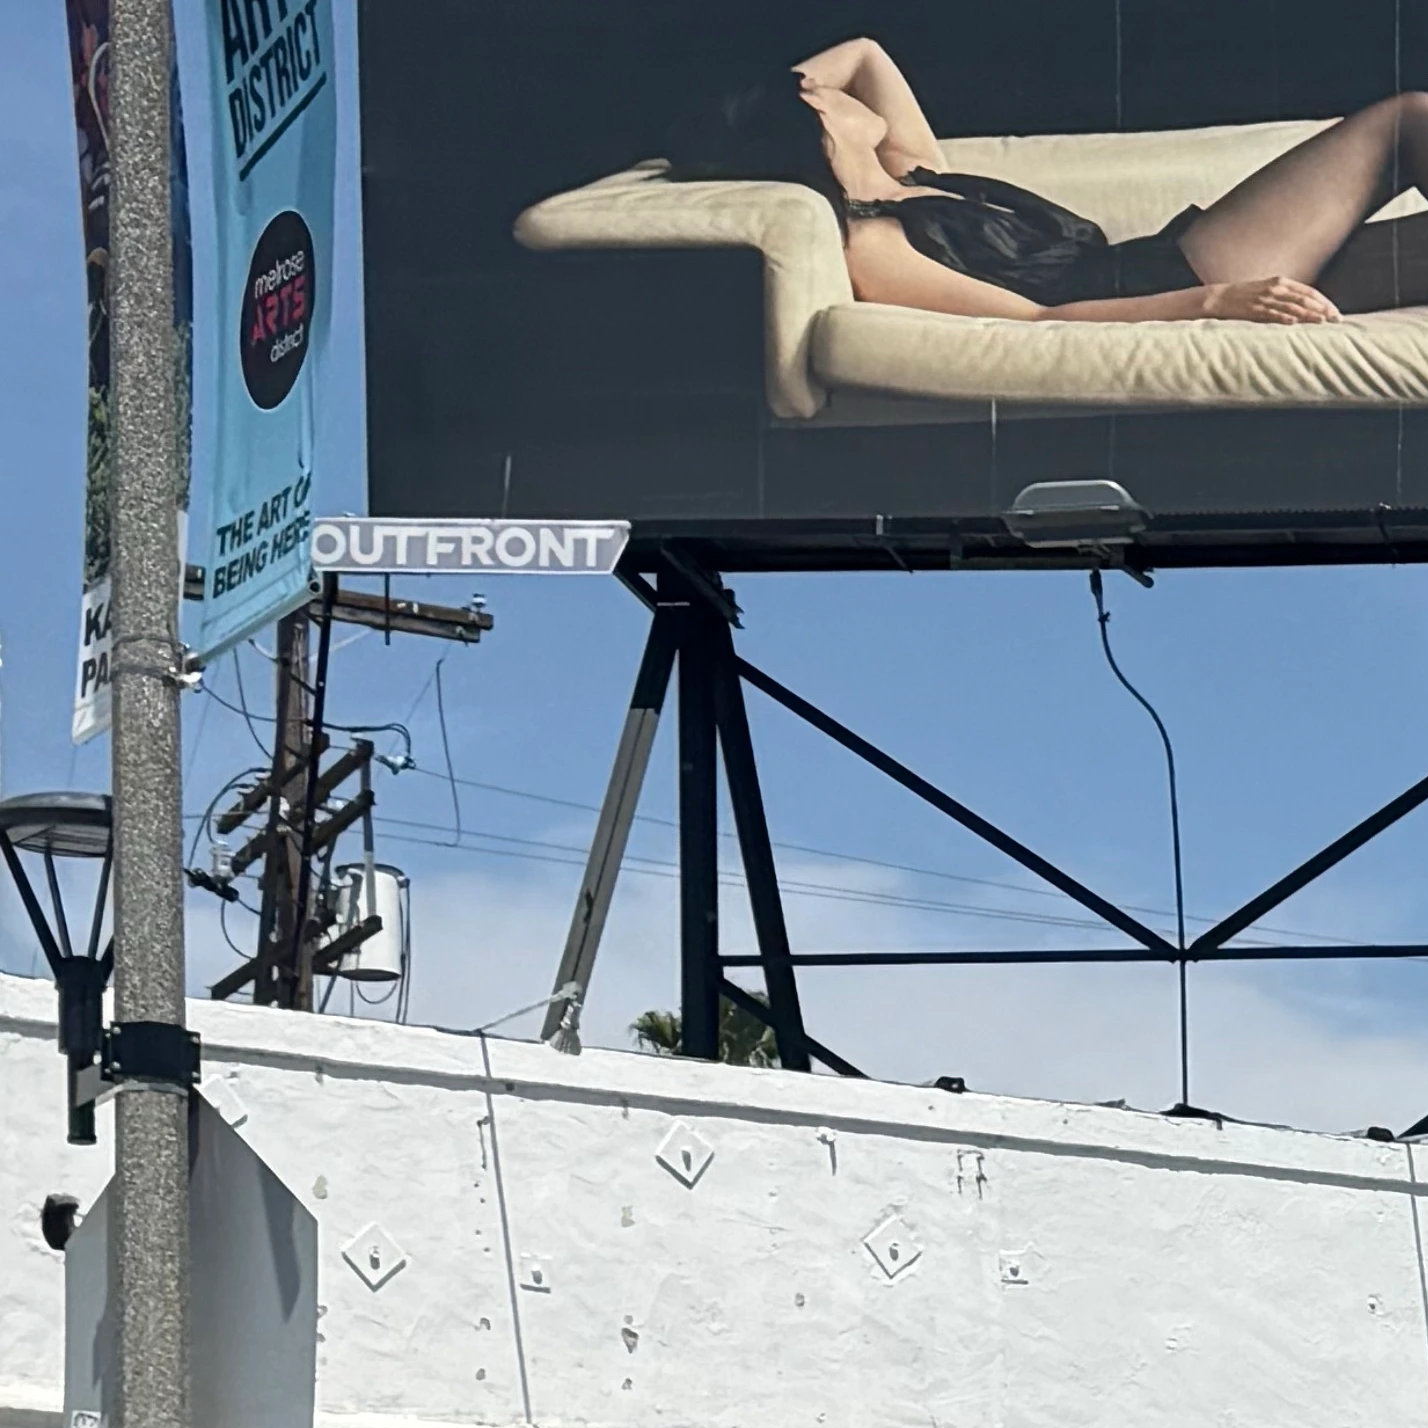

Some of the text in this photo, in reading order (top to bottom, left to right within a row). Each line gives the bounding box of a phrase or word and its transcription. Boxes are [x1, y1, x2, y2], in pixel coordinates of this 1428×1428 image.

[229, 0, 320, 158] DISTRICT
[255, 250, 305, 299] melrose
[251, 275, 305, 347] ARTS
[217, 510, 255, 556] THE
[257, 486, 292, 536] ART
[311, 524, 615, 567] OUTFRONT
[213, 541, 268, 599] BEING
